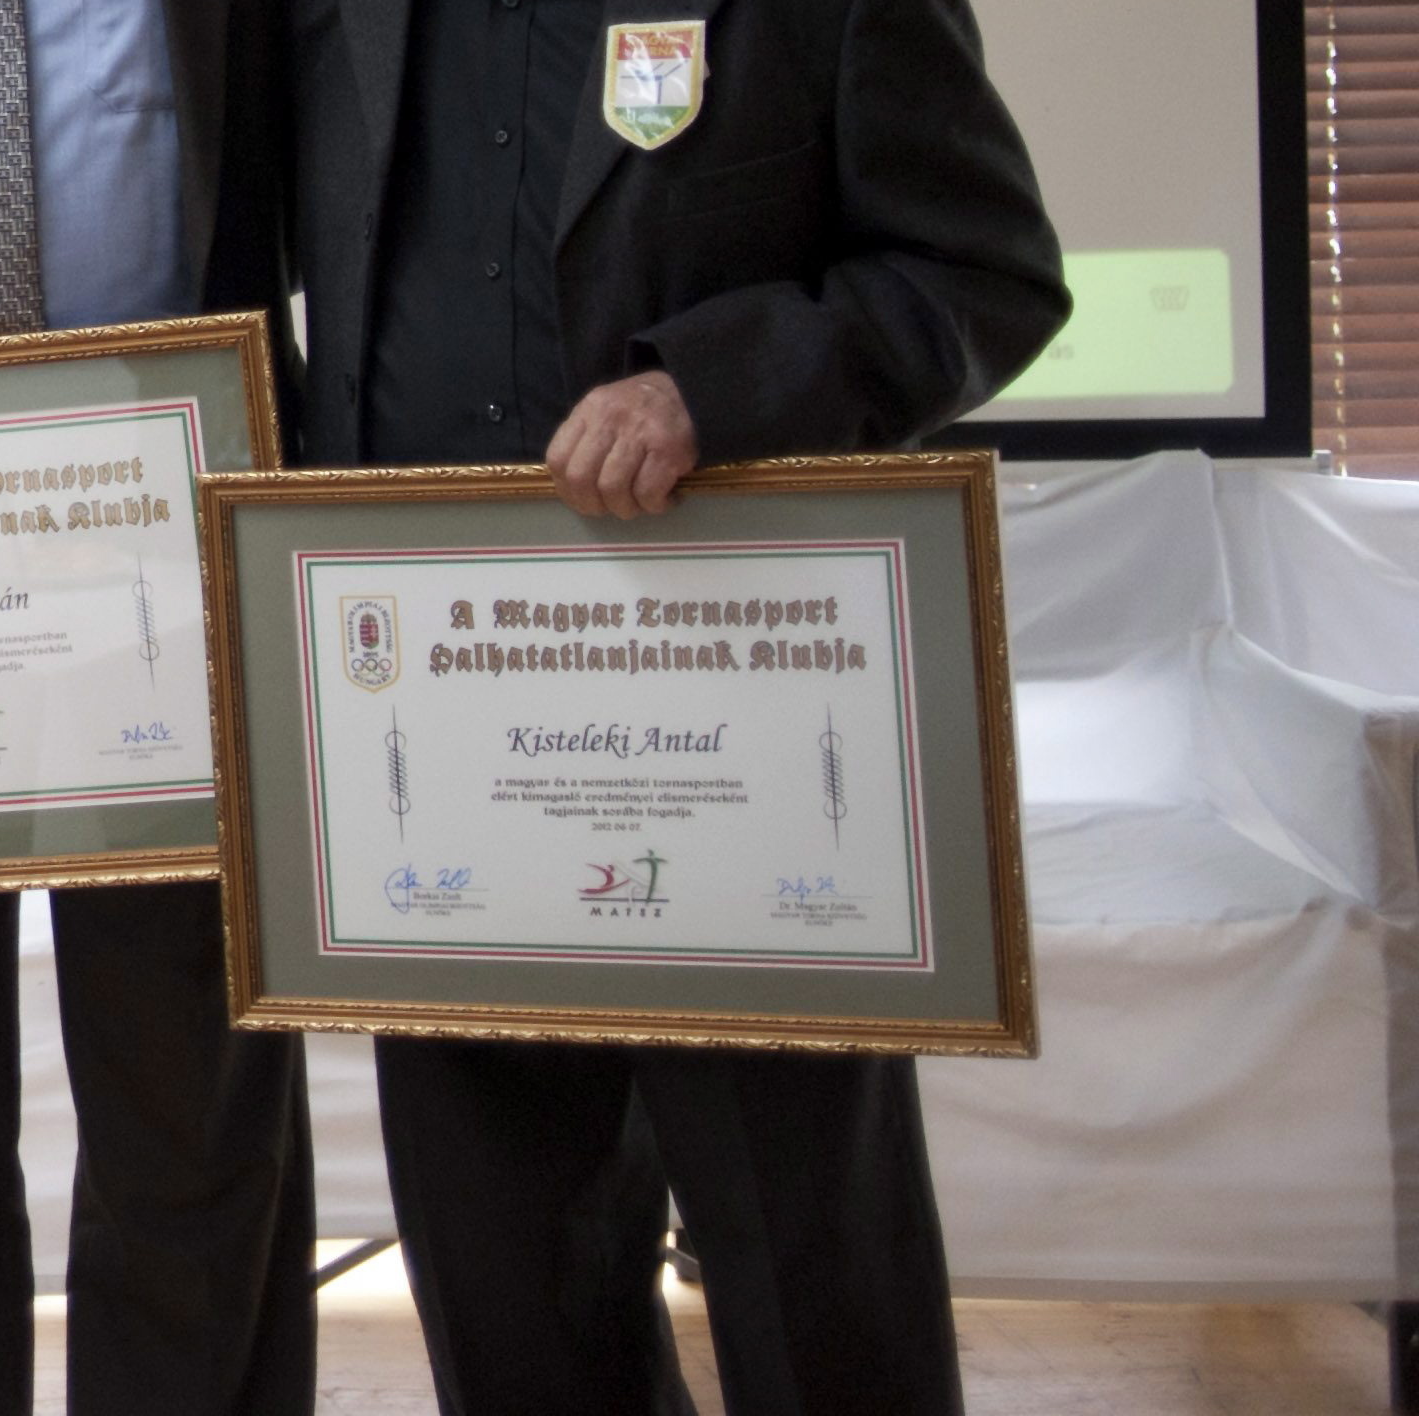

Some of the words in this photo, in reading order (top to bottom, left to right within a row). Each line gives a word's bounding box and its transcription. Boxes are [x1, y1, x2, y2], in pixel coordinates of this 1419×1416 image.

[67, 494, 171, 530] Klubja
[450, 599, 474, 630] A
[493, 599, 626, 634] Magyar
[636, 596, 838, 631] Tornasport
[749, 638, 867, 674] Klubja
[507, 724, 632, 758] Kisteleki
[635, 724, 728, 756] Antal
[491, 792, 518, 801] elért
[522, 791, 581, 803] kimagasló
[585, 792, 653, 804] eredményei
[657, 793, 749, 803] elismeréseként
[505, 778, 550, 789] magyar
[581, 778, 650, 788] nemzetközi
[653, 779, 743, 790] tornasportban
[544, 806, 598, 818] tagjainak
[602, 806, 643, 816] sorába
[647, 807, 695, 818] fogadja.
